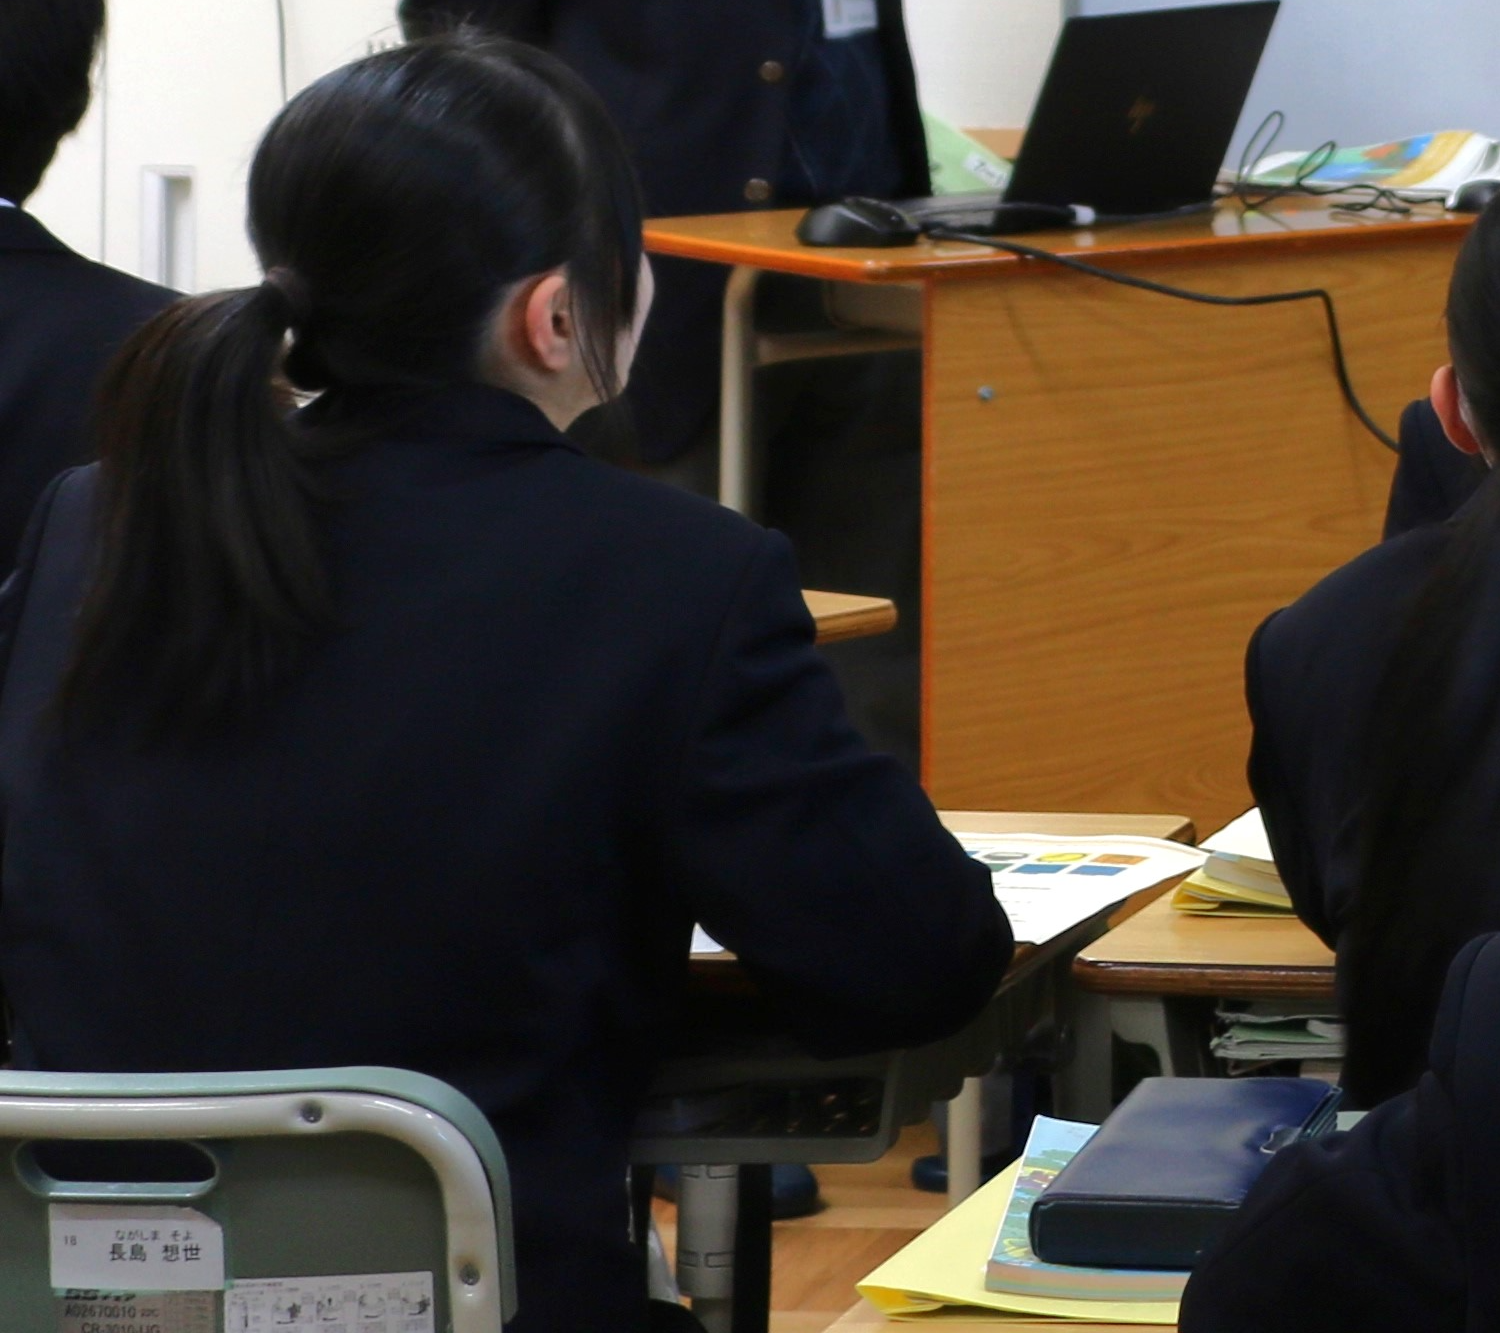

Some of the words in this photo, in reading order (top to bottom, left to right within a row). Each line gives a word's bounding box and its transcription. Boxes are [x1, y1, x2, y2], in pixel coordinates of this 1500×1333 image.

[115, 1229, 161, 1241] ながしま
[64, 1236, 77, 1247] 18
[110, 1243, 147, 1262] 長島
[162, 1243, 201, 1262] 想世
